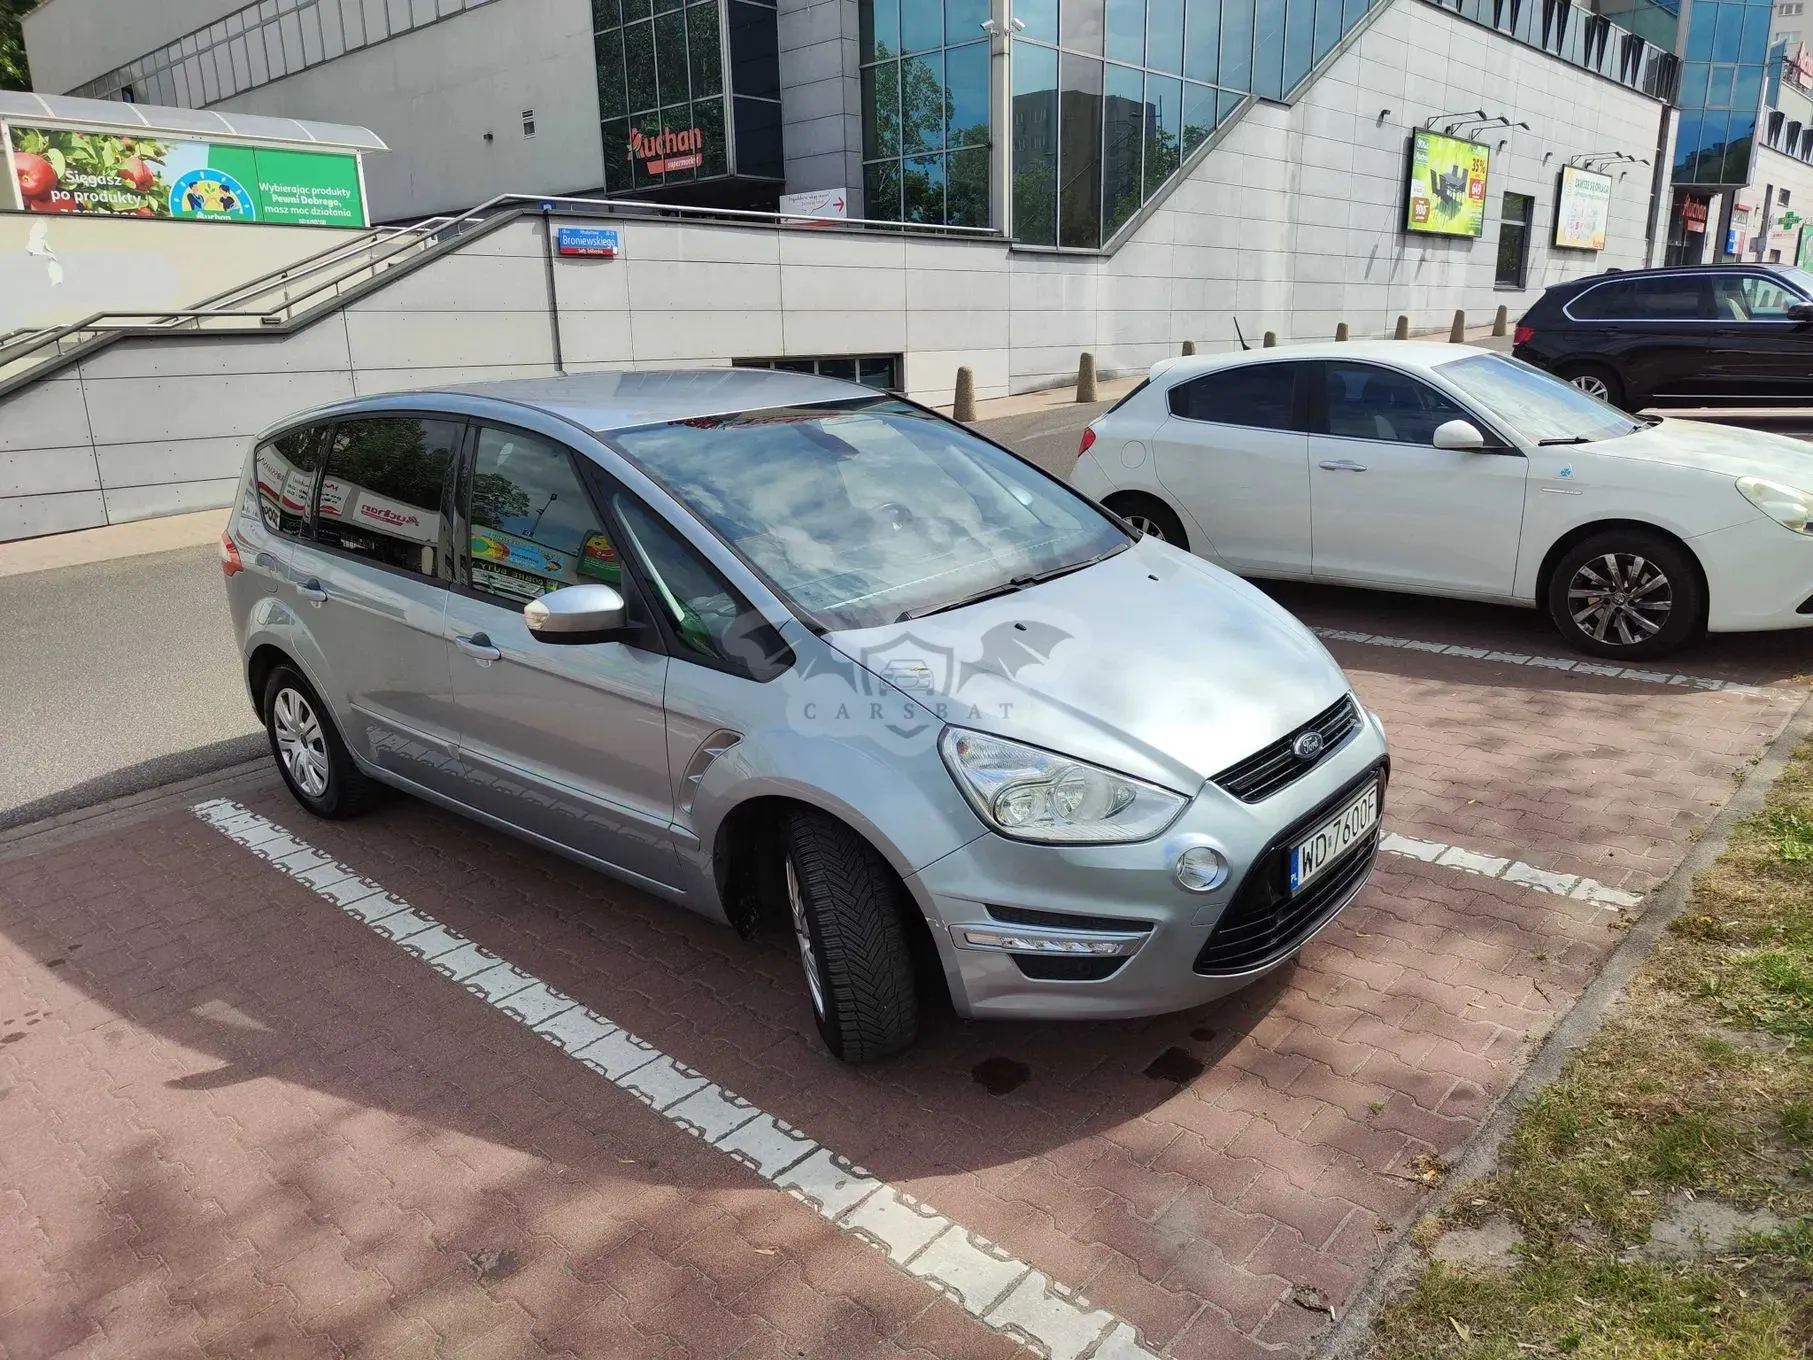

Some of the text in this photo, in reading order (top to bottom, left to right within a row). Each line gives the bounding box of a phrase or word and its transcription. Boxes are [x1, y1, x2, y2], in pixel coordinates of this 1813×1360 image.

[627, 127, 702, 160] Auchan
[65, 169, 122, 188] Sięgasz
[50, 190, 142, 206] po produkty
[259, 183, 351, 198] Wybierając produkty
[264, 205, 352, 217] masz moc działania
[562, 235, 616, 249] Broniewskiego
[1302, 788, 1376, 878] WD 7600F
[1290, 872, 1298, 885] PL
